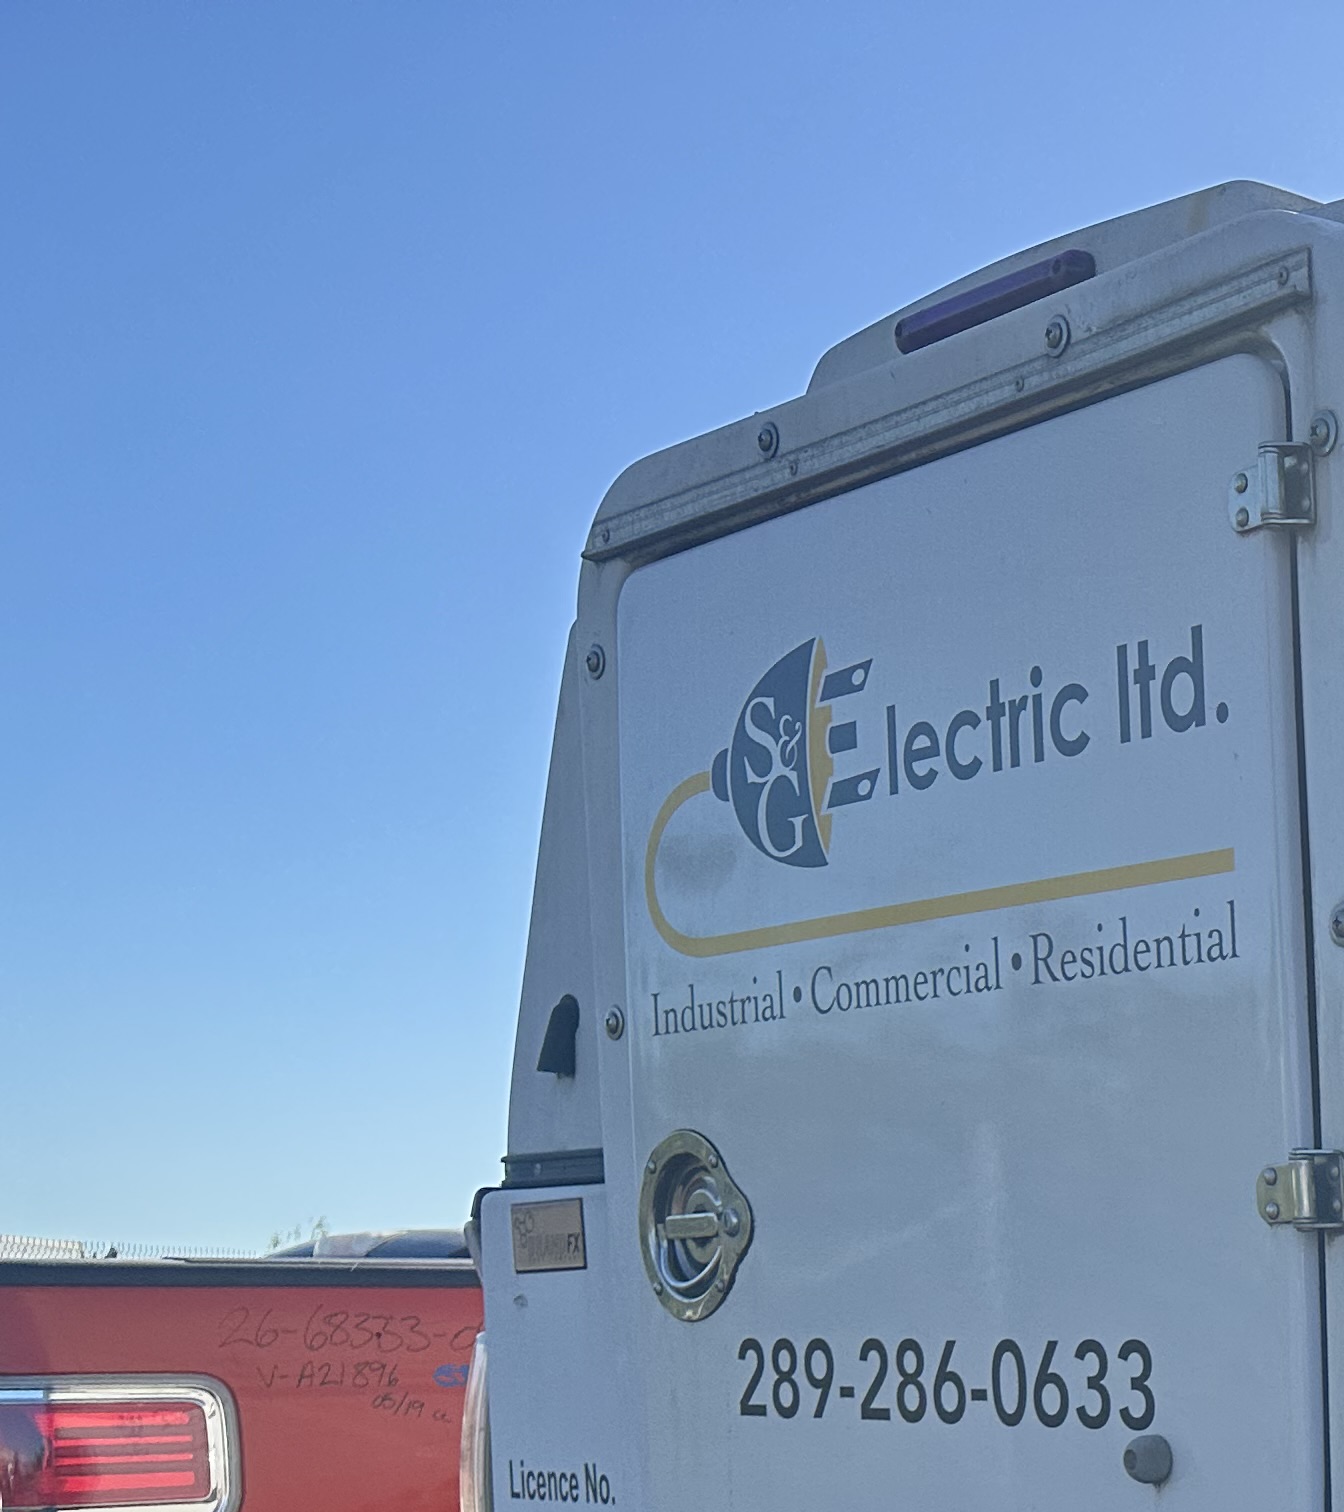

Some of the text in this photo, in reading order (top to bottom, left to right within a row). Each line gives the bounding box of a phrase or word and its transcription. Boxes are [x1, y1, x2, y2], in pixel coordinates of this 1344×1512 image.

[1116, 623, 1230, 745] ltd.
[651, 899, 1241, 1038] Industrial Commercial Residential
[737, 1336, 1156, 1432] 289-286-0633
[508, 1458, 617, 1507] Licence No.
